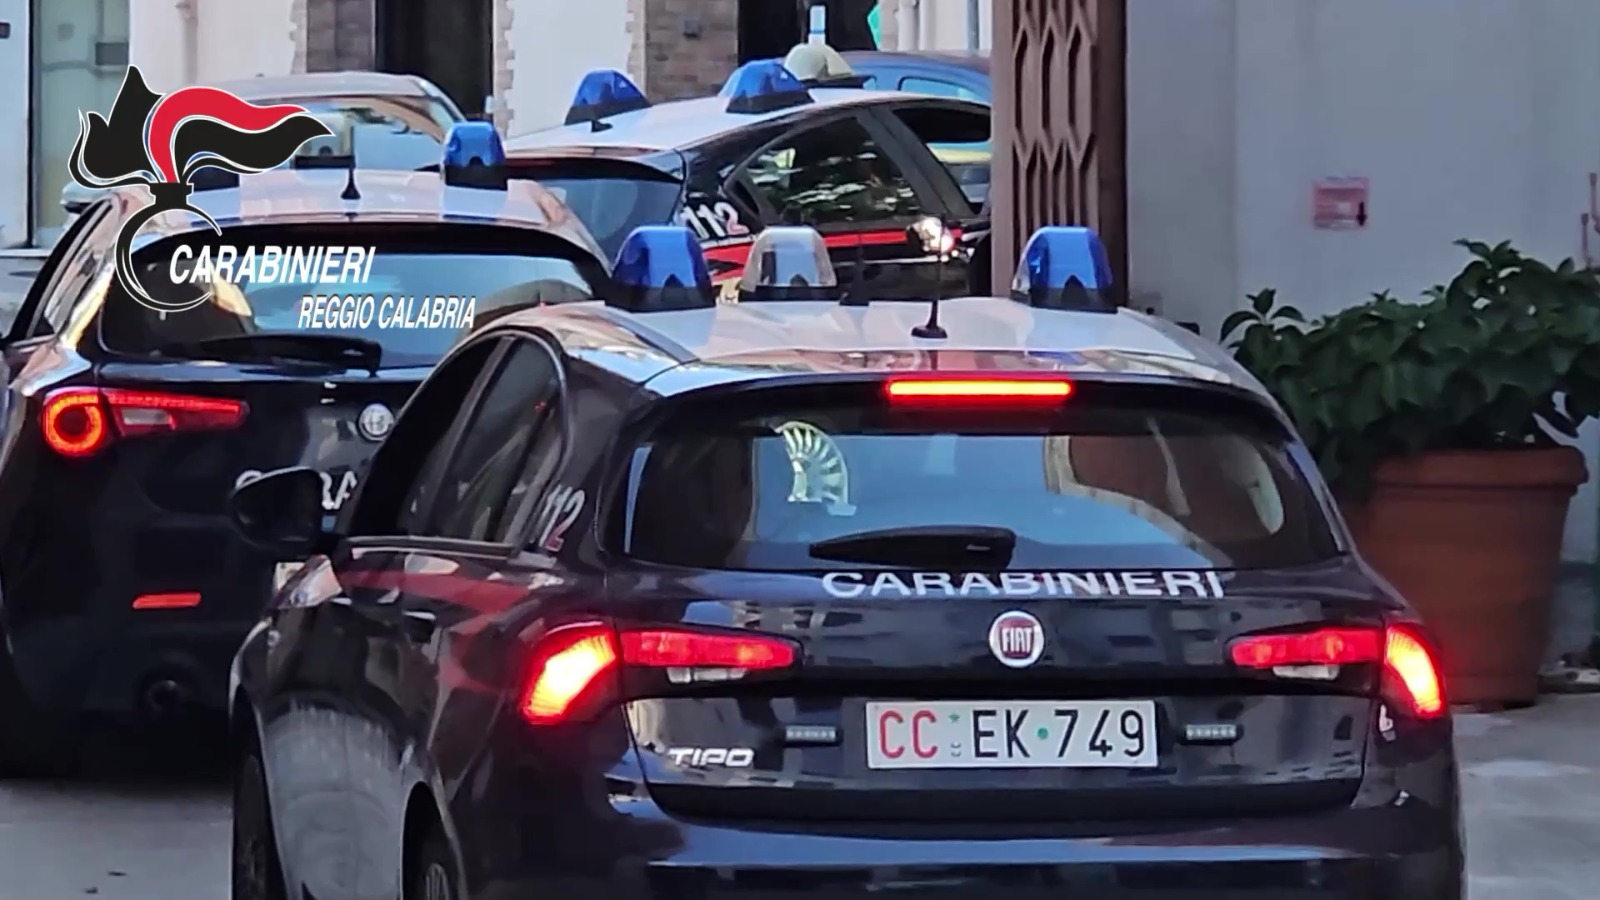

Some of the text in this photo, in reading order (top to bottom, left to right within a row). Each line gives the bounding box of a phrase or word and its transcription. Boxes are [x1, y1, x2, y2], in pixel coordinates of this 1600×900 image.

[680, 202, 750, 239] 112
[531, 484, 585, 553] 112
[822, 571, 1225, 598] CARABINIERI
[1001, 626, 1034, 654] FIAT
[879, 709, 1144, 758] CC EK 749
[668, 748, 754, 767] TIPO
